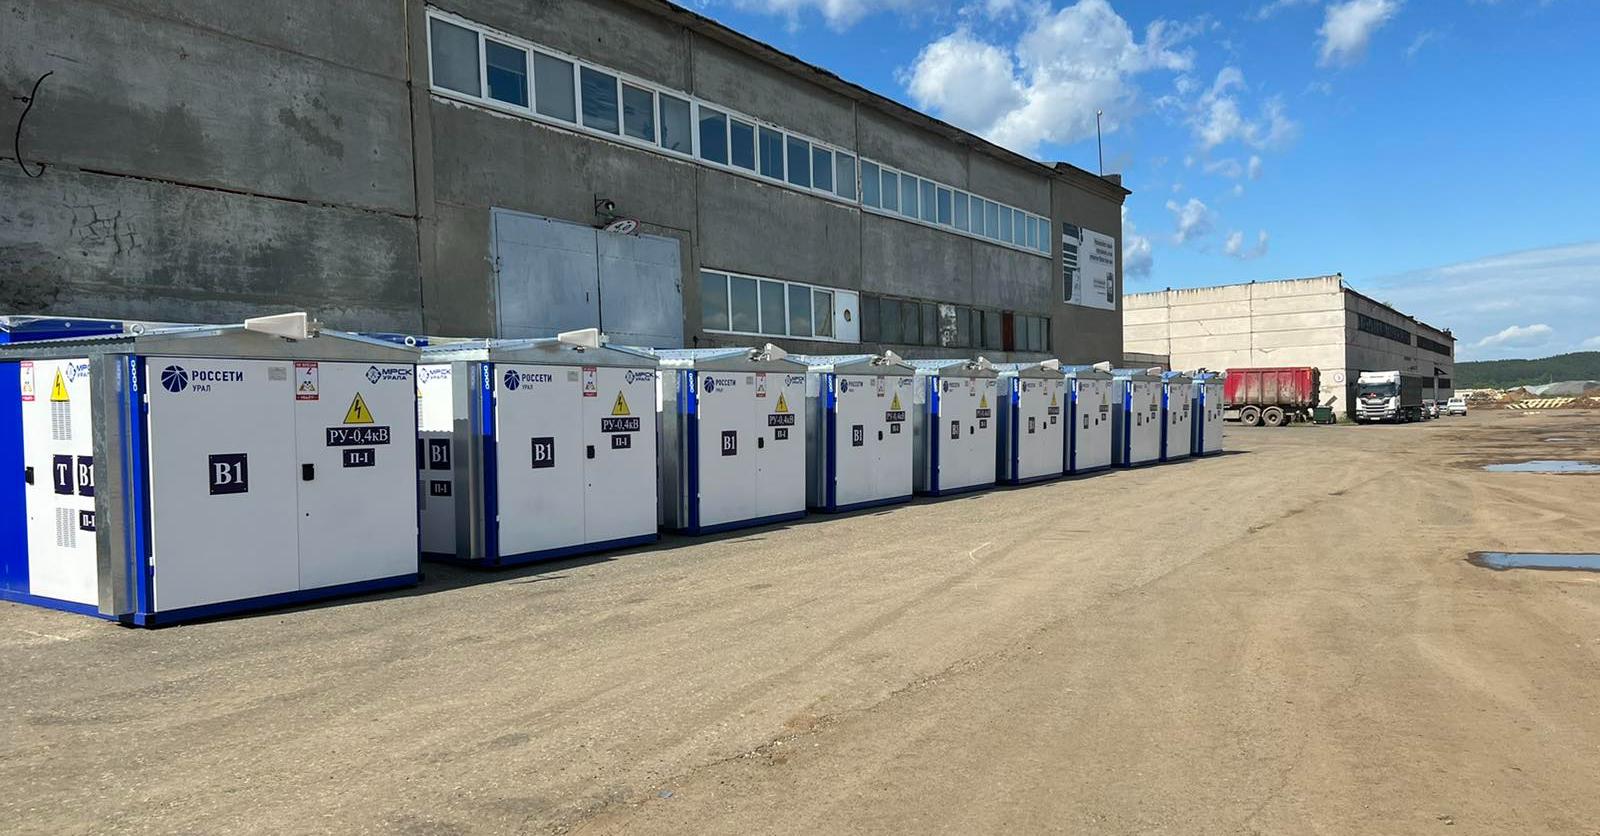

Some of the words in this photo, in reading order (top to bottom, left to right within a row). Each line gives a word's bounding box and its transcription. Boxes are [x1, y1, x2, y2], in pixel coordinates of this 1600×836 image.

[192, 370, 243, 382] РОССЕТИ
[521, 373, 552, 382] РОССЕТИ
[192, 384, 211, 392] УРАЛ
[329, 428, 389, 444] РУ-0,4кВ
[723, 435, 736, 450] В1
[432, 444, 449, 462] В1
[534, 443, 552, 461] В1
[56, 463, 68, 486] Т
[79, 463, 95, 487] В1
[213, 461, 244, 485] В1
